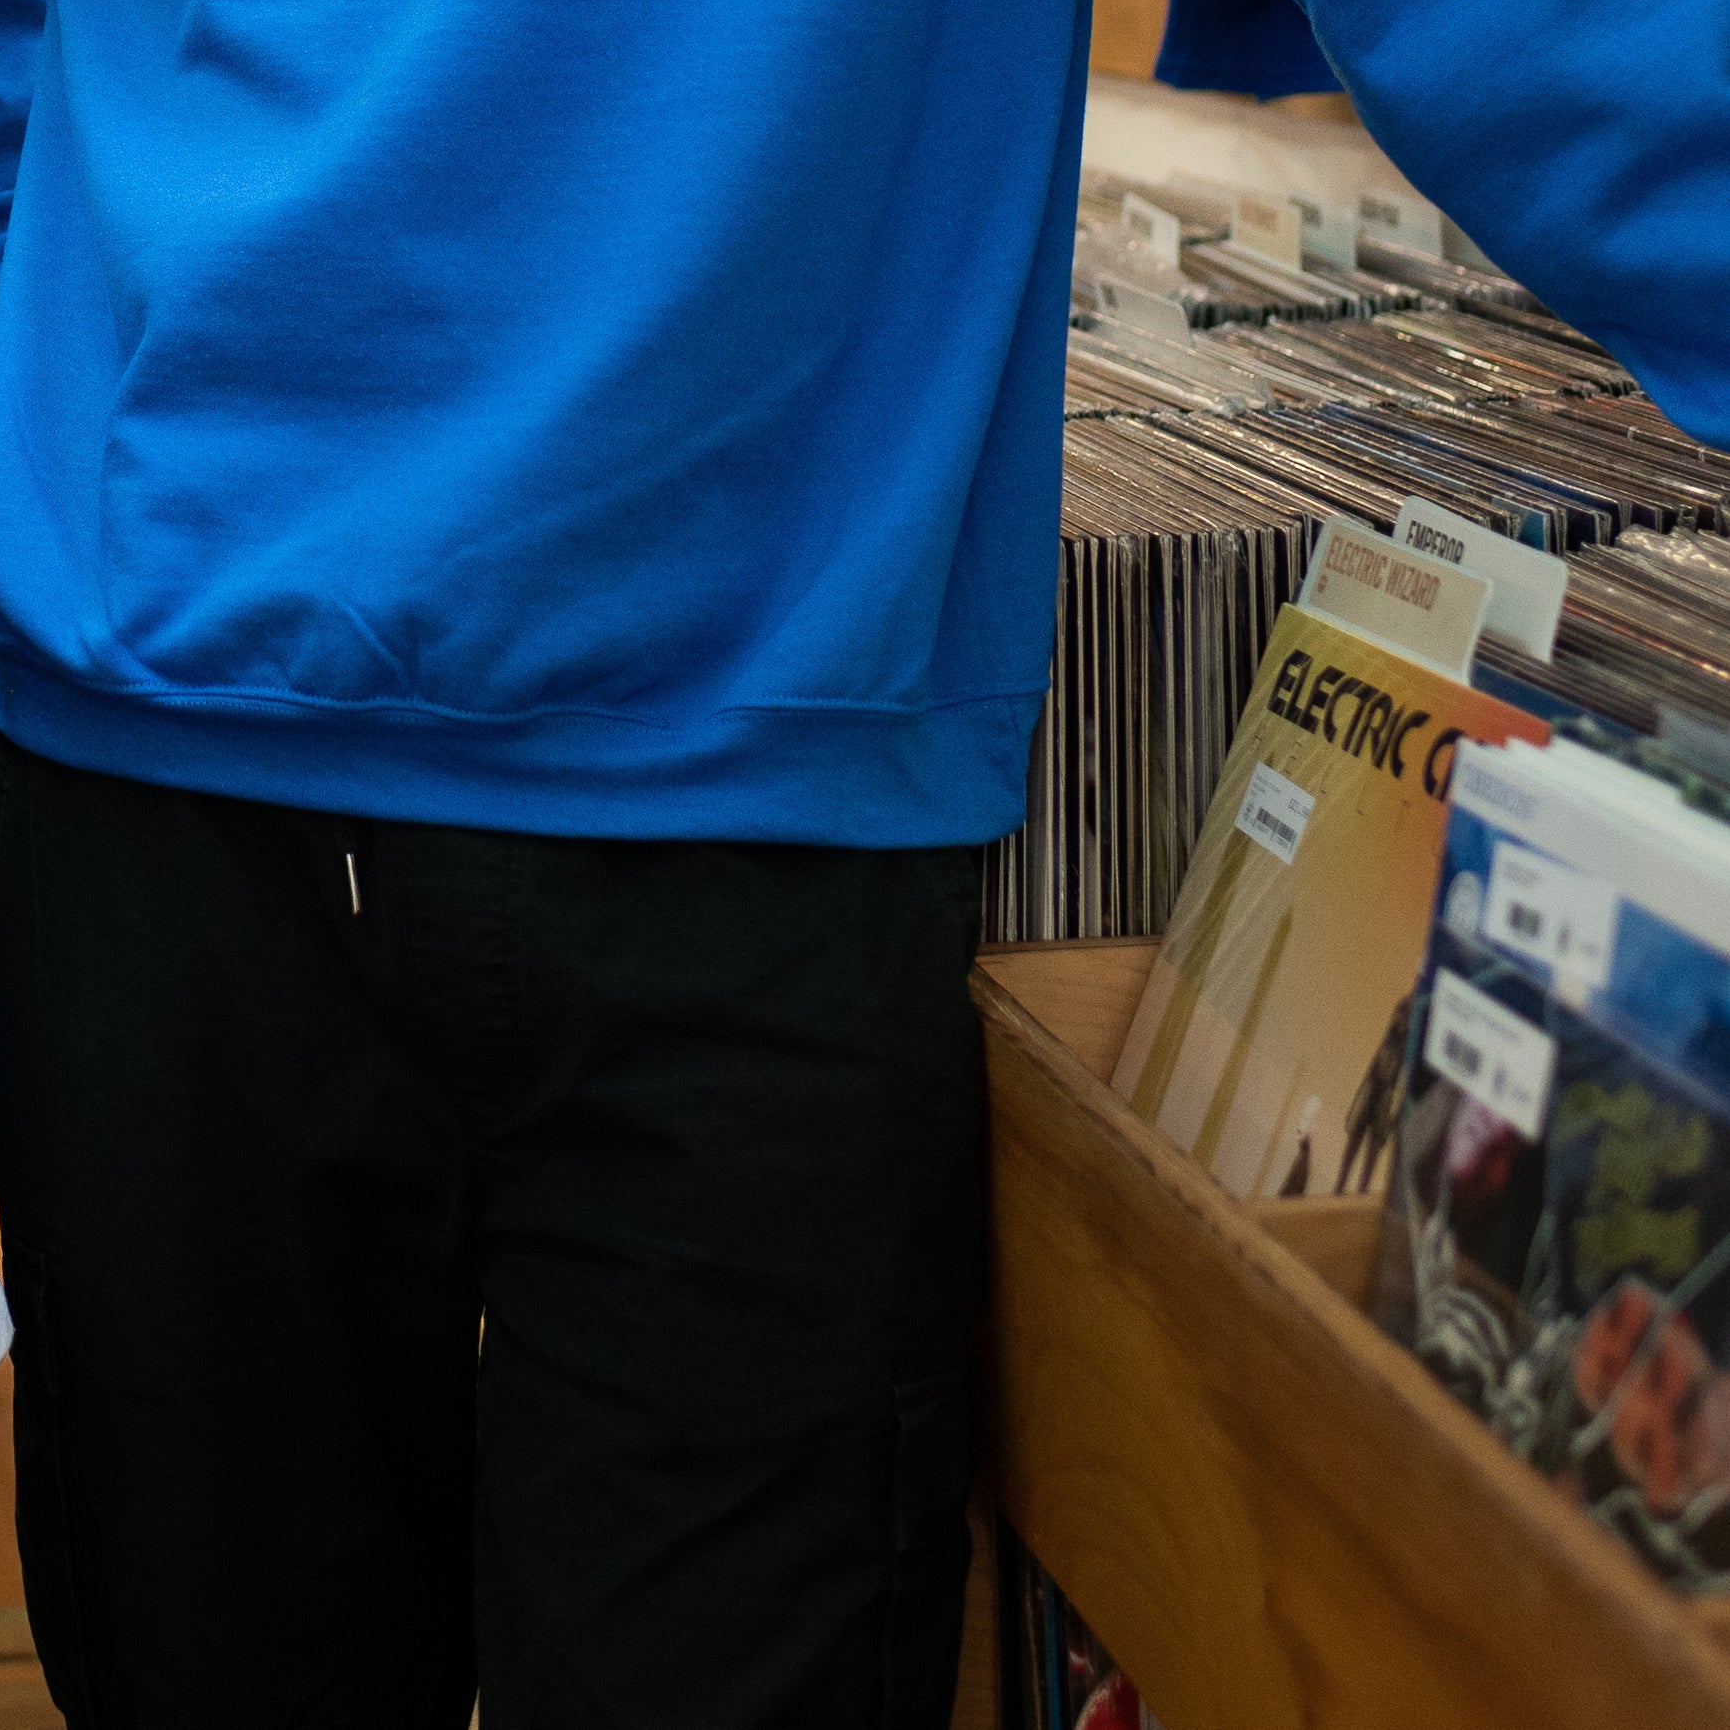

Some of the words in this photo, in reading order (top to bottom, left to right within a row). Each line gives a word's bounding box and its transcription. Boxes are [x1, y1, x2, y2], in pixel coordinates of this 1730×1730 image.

[1325, 534, 1388, 589] ELECTRIC
[1384, 558, 1441, 612] WIZARD
[1406, 520, 1466, 564] EMPEROR
[1266, 648, 1432, 779] ELECTRIC
